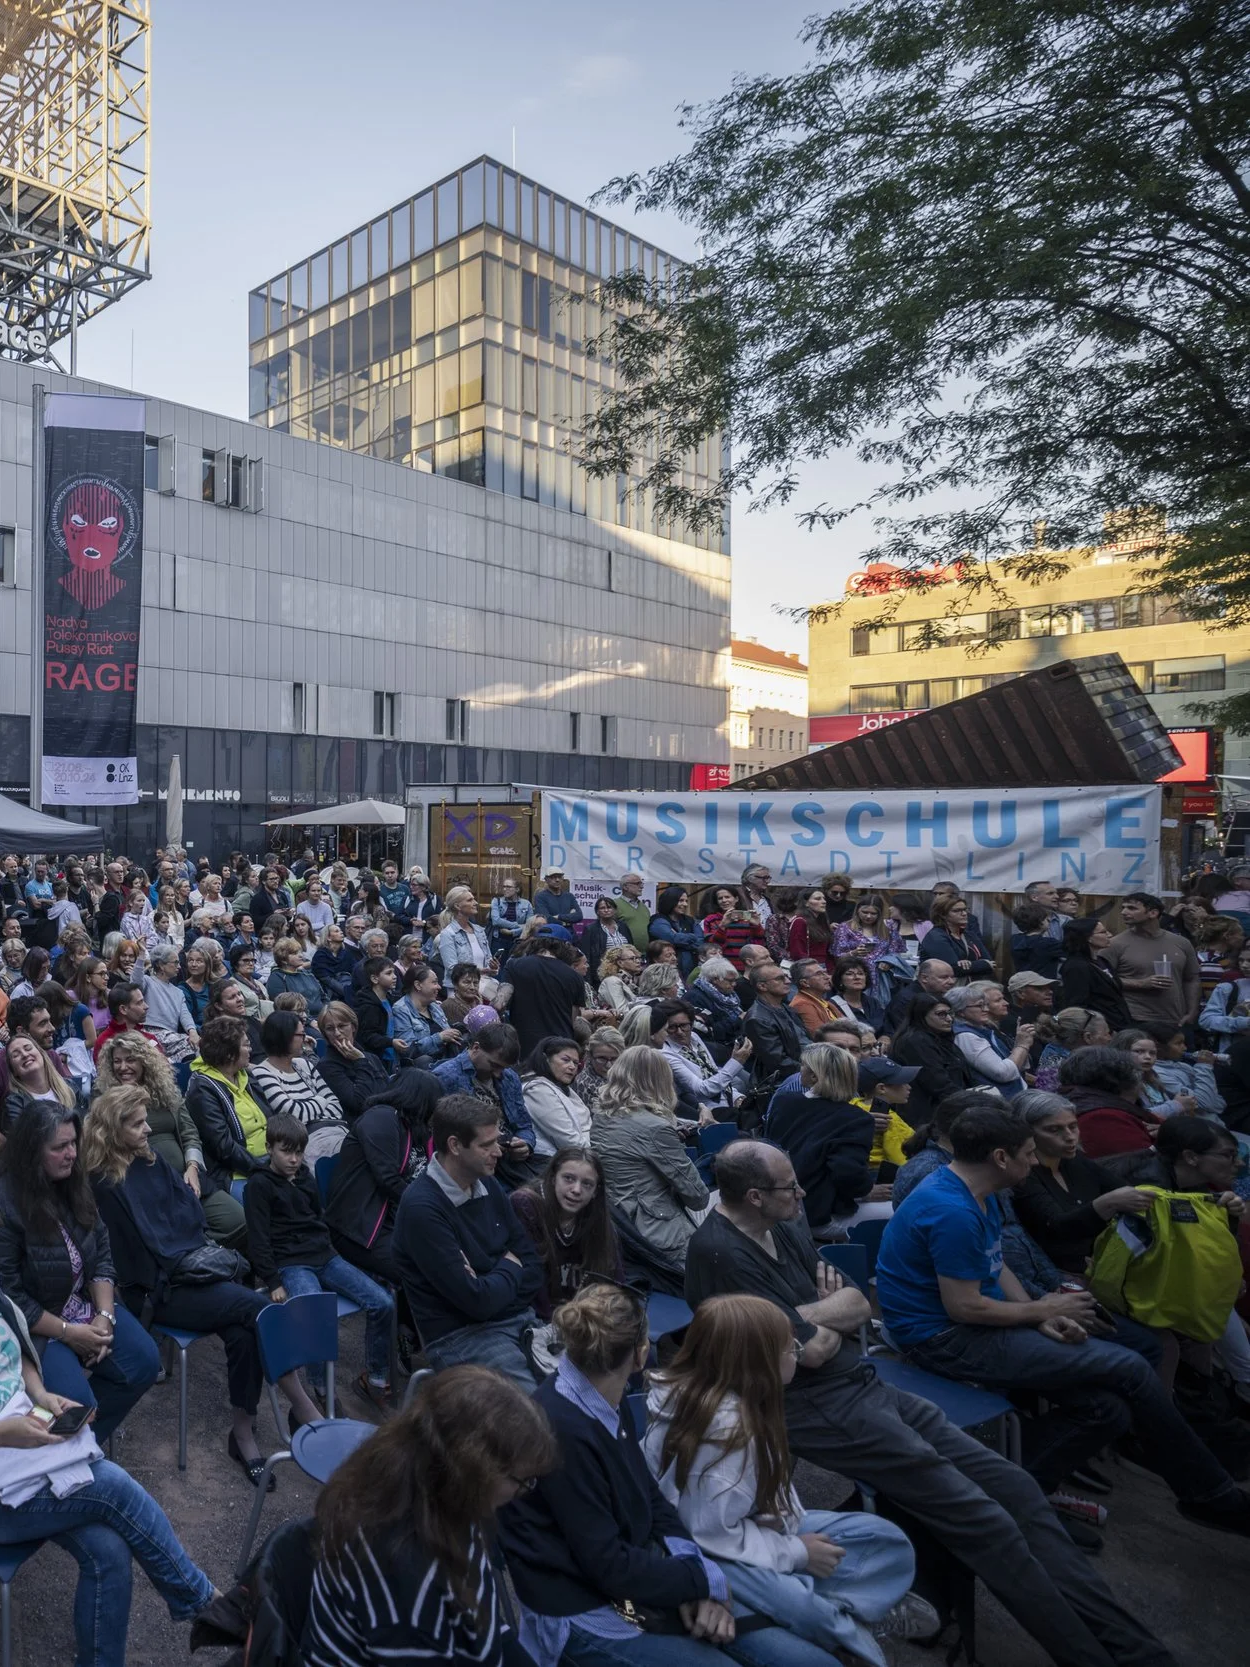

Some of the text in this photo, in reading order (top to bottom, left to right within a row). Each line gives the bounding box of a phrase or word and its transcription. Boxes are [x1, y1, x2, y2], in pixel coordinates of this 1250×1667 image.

[46, 614, 88, 630] Nadya
[46, 640, 114, 656] Pussy Riot
[46, 661, 137, 692] RAGE
[158, 788, 241, 801] MIEMENTO
[549, 797, 1147, 849] MUSIKSCHULE
[549, 844, 1146, 884] DER STADT LINZ
[574, 883, 607, 892] Musik-
[579, 900, 593, 908] inz
